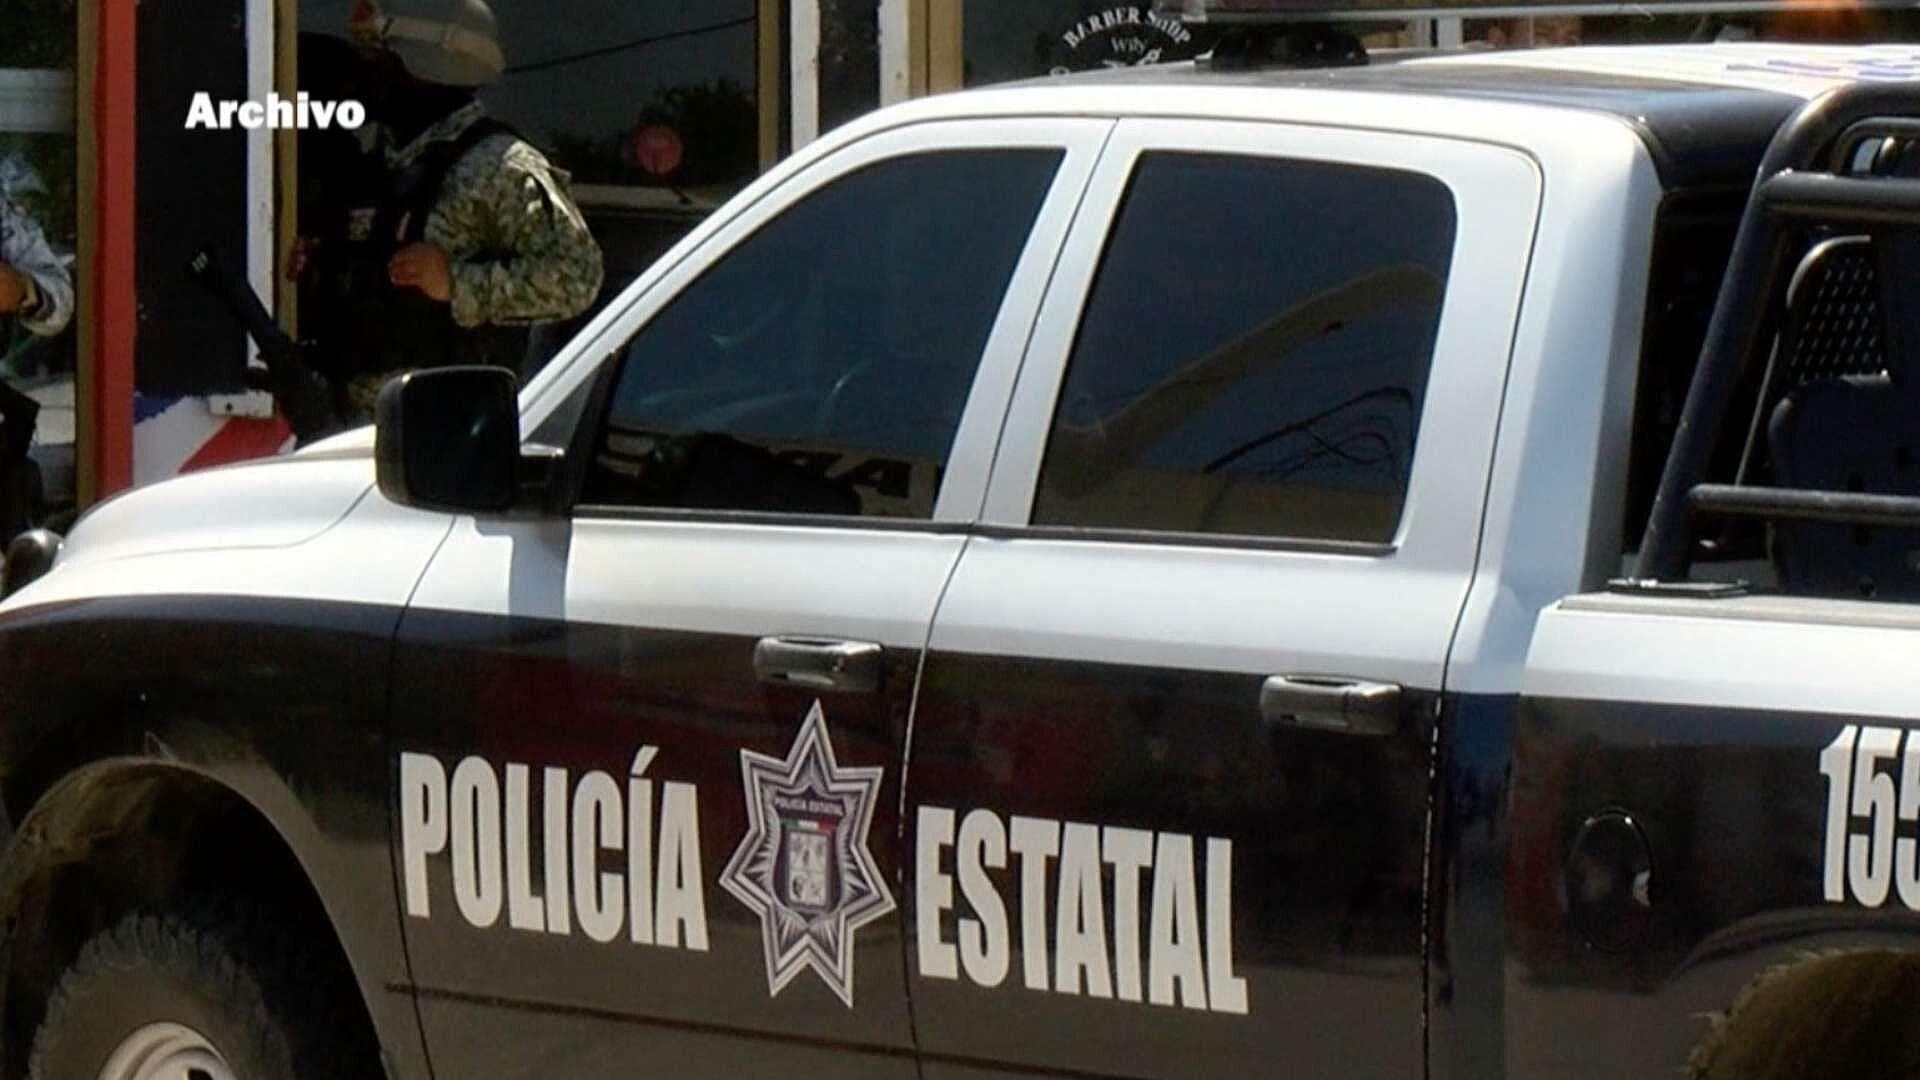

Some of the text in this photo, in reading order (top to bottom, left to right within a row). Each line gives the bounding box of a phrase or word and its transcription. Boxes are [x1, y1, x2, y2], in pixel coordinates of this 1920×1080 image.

[1062, 6, 1141, 48] BARBER
[401, 745, 1249, 1015] POLICÍA ESTATAL
